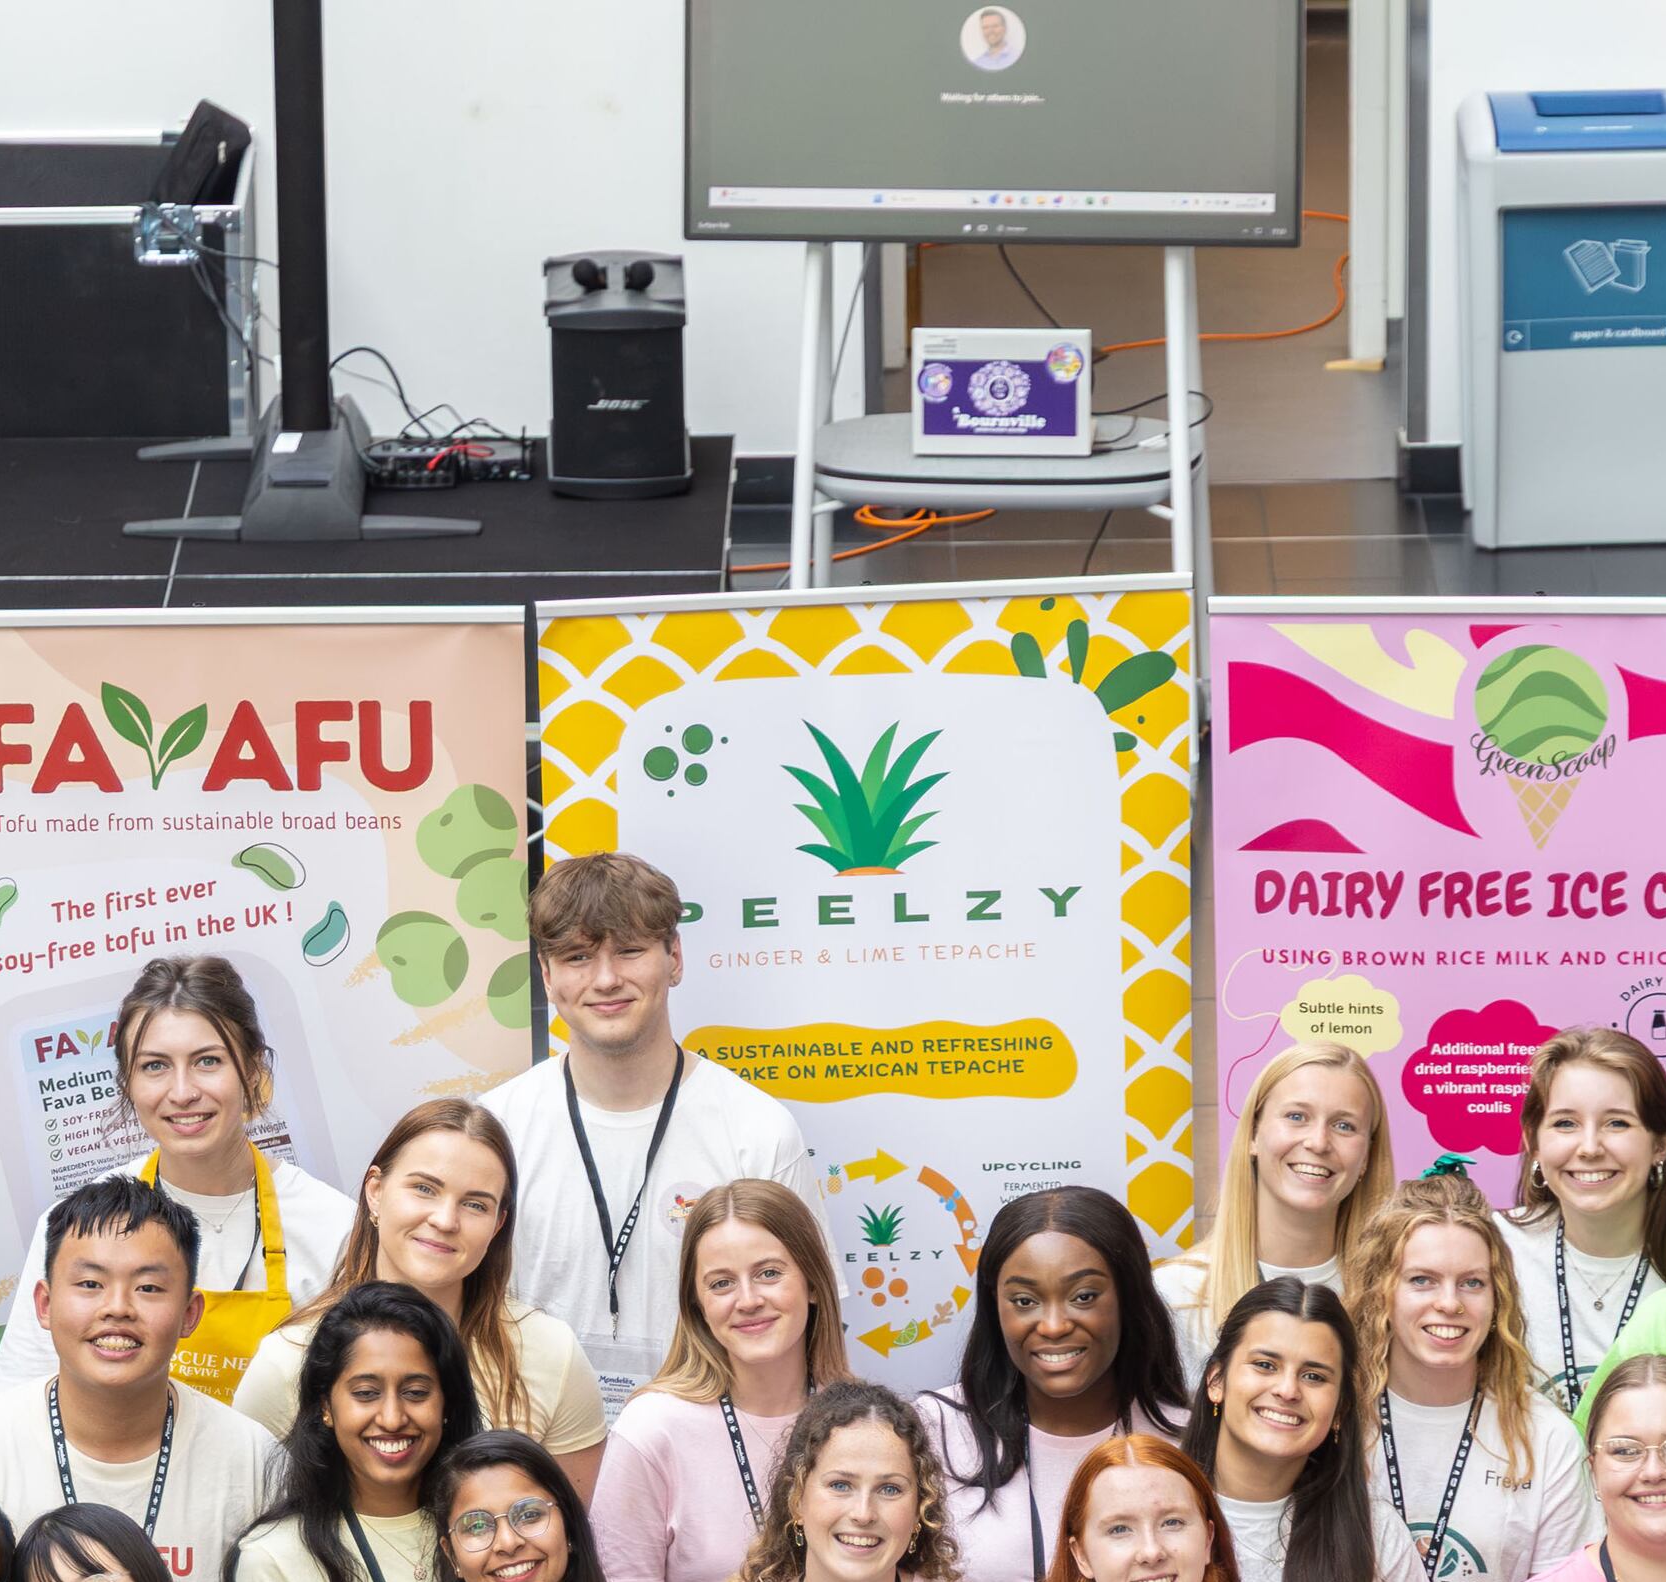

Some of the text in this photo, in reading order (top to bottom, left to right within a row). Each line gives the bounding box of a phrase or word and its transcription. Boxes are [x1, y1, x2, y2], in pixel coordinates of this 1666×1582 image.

[46, 813, 99, 832] made
[108, 812, 154, 831] from
[162, 811, 274, 831] sustainable
[282, 811, 337, 830] broad
[345, 811, 402, 830] beans
[52, 879, 217, 924] The first ever
[1253, 869, 1404, 920] DAIRY
[1419, 871, 1532, 919] FREE
[1546, 872, 1628, 919] ICE
[104, 928, 156, 956] tofu
[166, 922, 188, 943] in
[197, 914, 236, 937] the
[244, 904, 279, 929] UK
[709, 943, 1037, 969] GINGER & LIME TEPACHE
[1262, 949, 1332, 966] USING
[1342, 949, 1426, 966] BROWN
[1436, 950, 1485, 966] RICE
[1495, 950, 1550, 966] MILK
[1560, 951, 1606, 966] AND
[1620, 977, 1663, 1002] DAIRY
[1299, 1001, 1384, 1015] Subtle hints
[1310, 1022, 1372, 1035] of lemon
[717, 1042, 863, 1060] SUSTAINABLE
[871, 1040, 914, 1055] AND
[923, 1036, 1053, 1053] REFRESHING
[1431, 1042, 1504, 1056] Additional
[787, 1065, 816, 1079] ON
[824, 1062, 919, 1078] MEXICAN
[927, 1059, 1024, 1074] TEPACHE
[38, 1069, 113, 1095] Medium
[42, 1093, 86, 1112] Fava
[982, 1160, 1081, 1172] UPCYCLING
[1485, 1470, 1532, 1493] Freya
